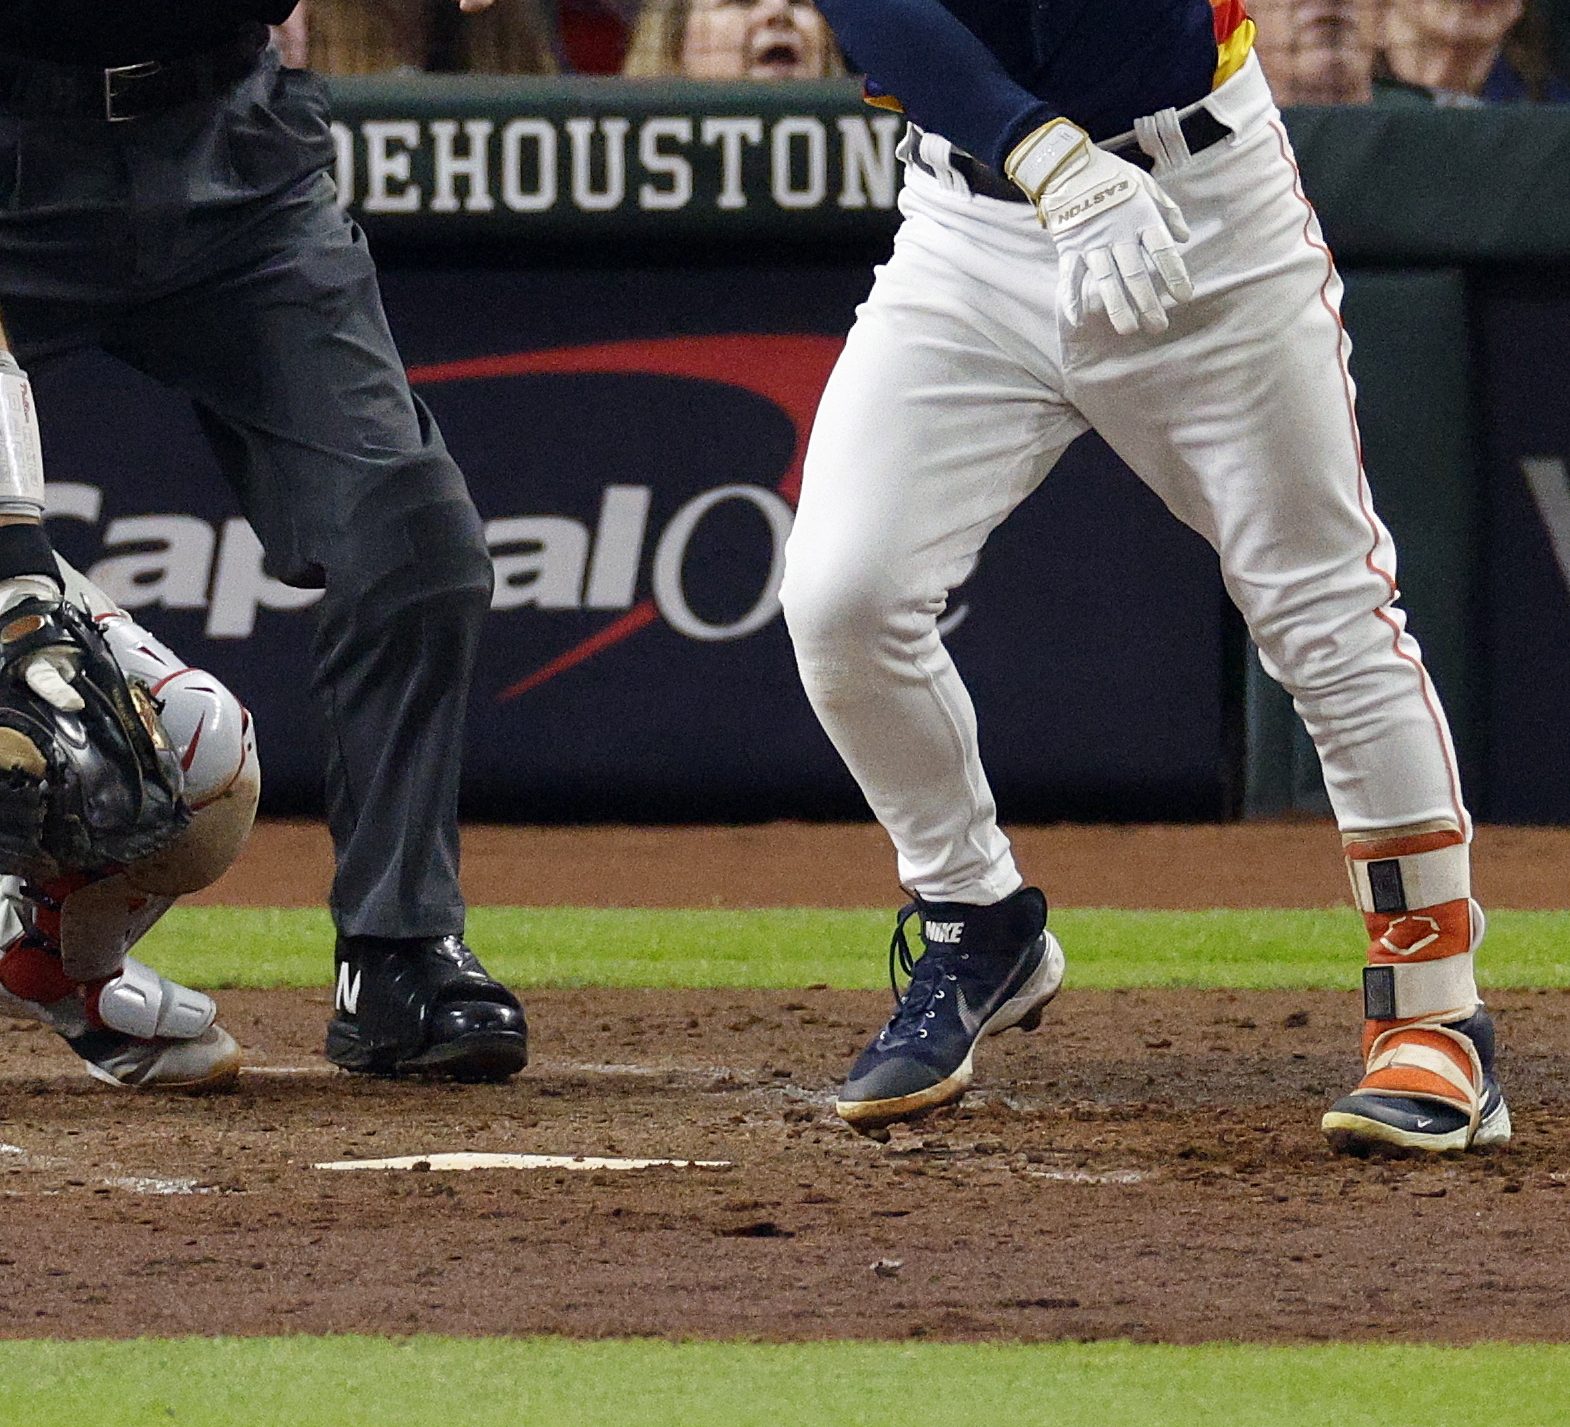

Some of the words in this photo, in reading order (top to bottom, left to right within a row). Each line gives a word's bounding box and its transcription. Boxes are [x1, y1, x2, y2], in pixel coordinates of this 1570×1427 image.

[1057, 179, 1129, 225] EASTON
[925, 920, 966, 943] NIKE
[335, 960, 362, 1014] N
